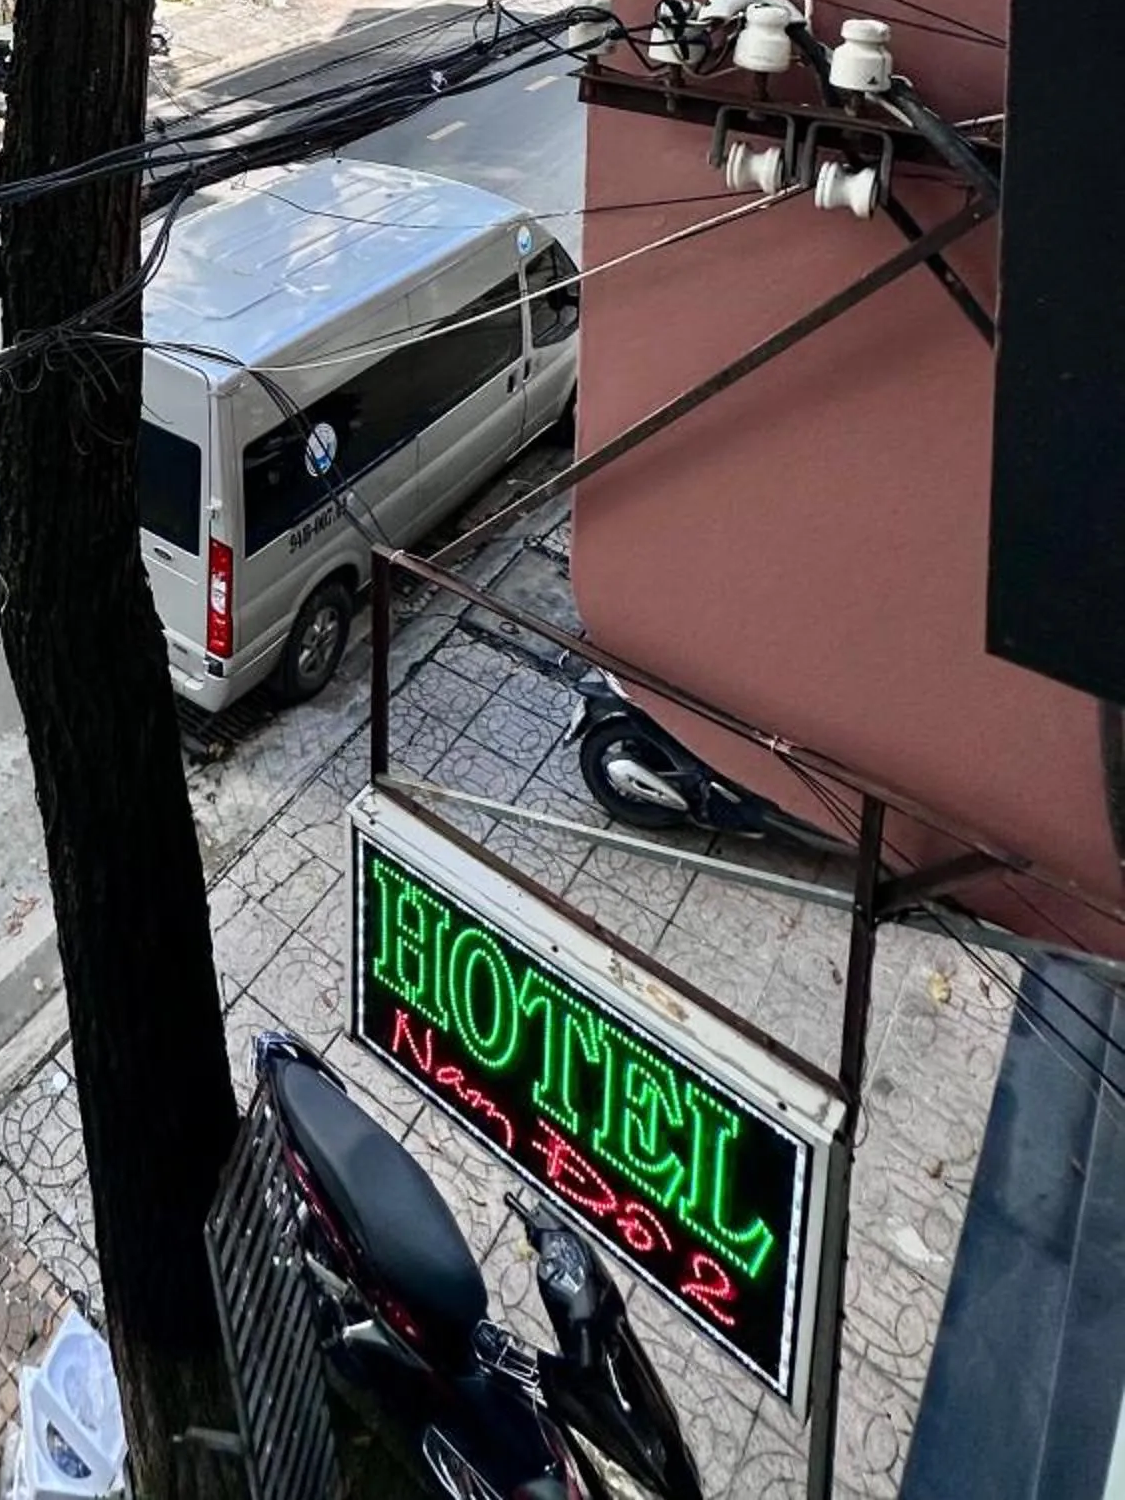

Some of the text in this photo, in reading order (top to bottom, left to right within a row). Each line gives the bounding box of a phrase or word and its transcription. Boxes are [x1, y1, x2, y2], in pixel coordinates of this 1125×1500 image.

[373, 859, 774, 1278] HOTEL
[393, 1008, 514, 1151] Nam
[680, 1252, 737, 1327] 2
